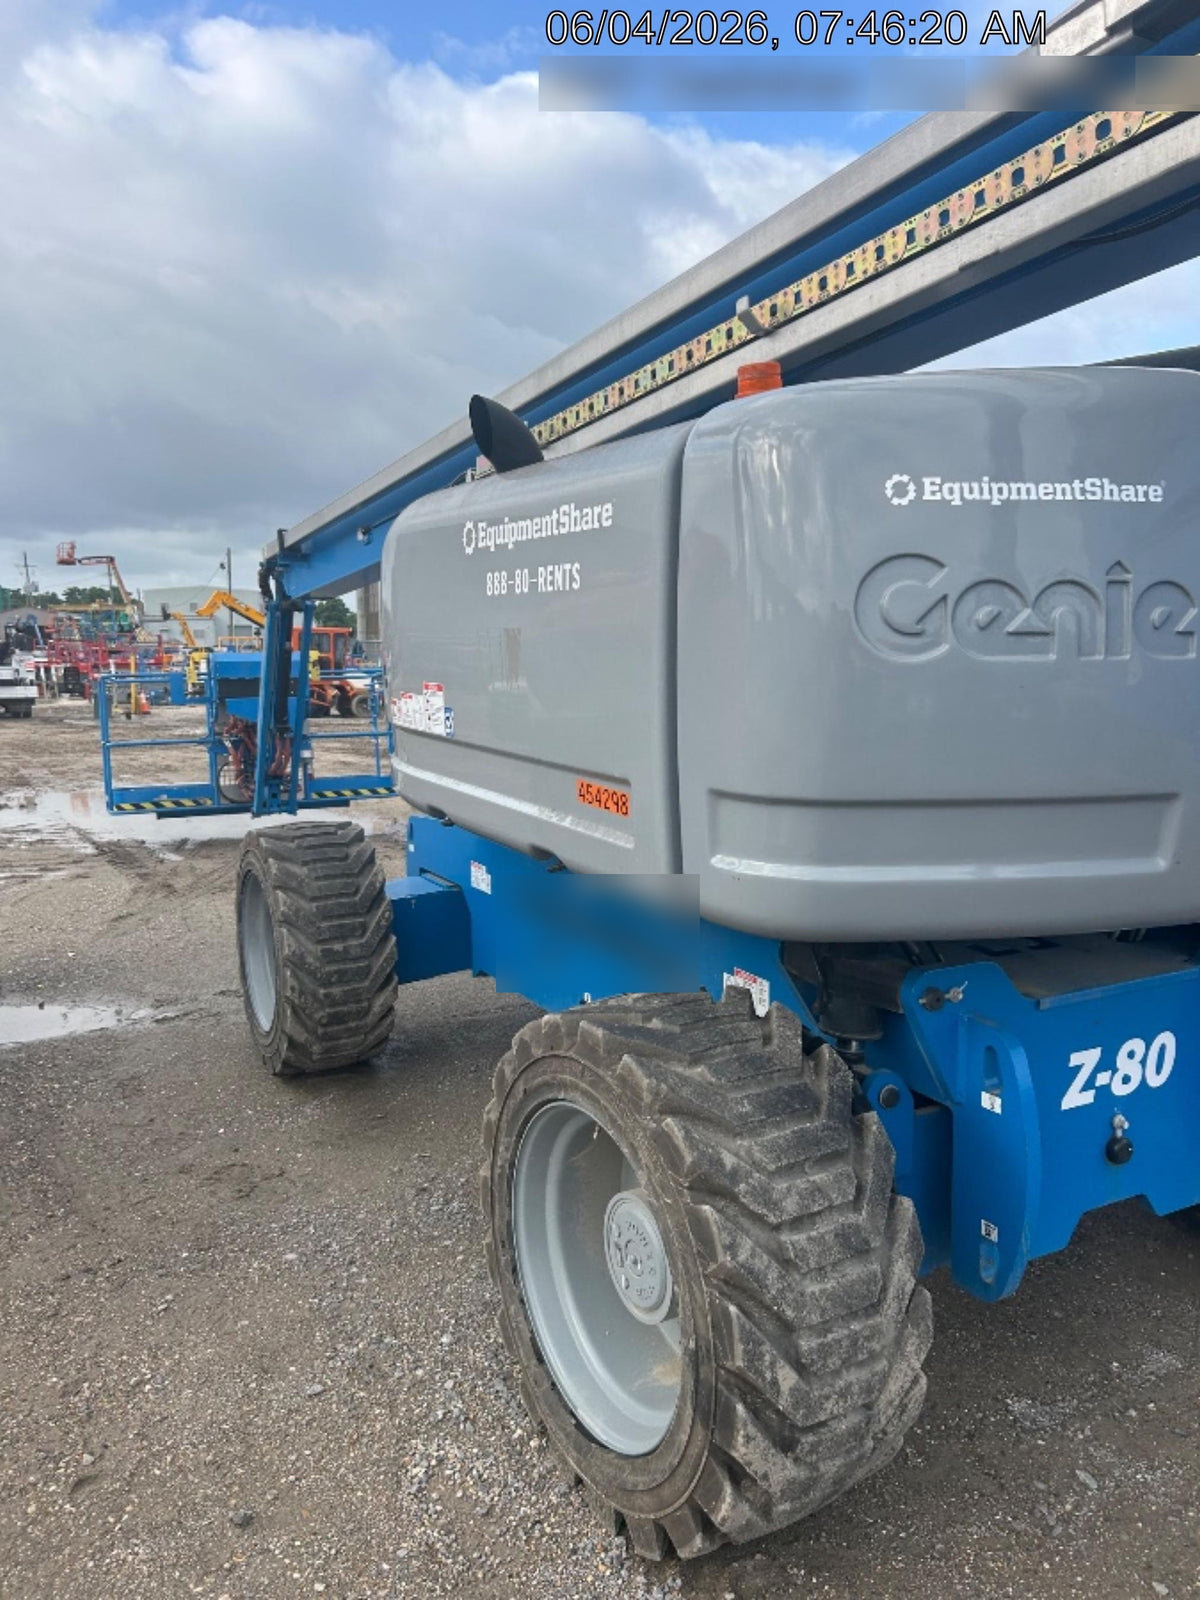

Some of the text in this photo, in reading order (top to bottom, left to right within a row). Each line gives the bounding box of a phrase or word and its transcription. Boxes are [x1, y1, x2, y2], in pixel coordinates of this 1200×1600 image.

[922, 476, 1164, 506] EquipmentShare
[477, 502, 613, 551] EquipmentShare
[486, 561, 581, 596] 888-80-RENTS
[853, 551, 1198, 663] Genie
[578, 781, 629, 816] 454298
[1060, 1030, 1177, 1111] Z-80
